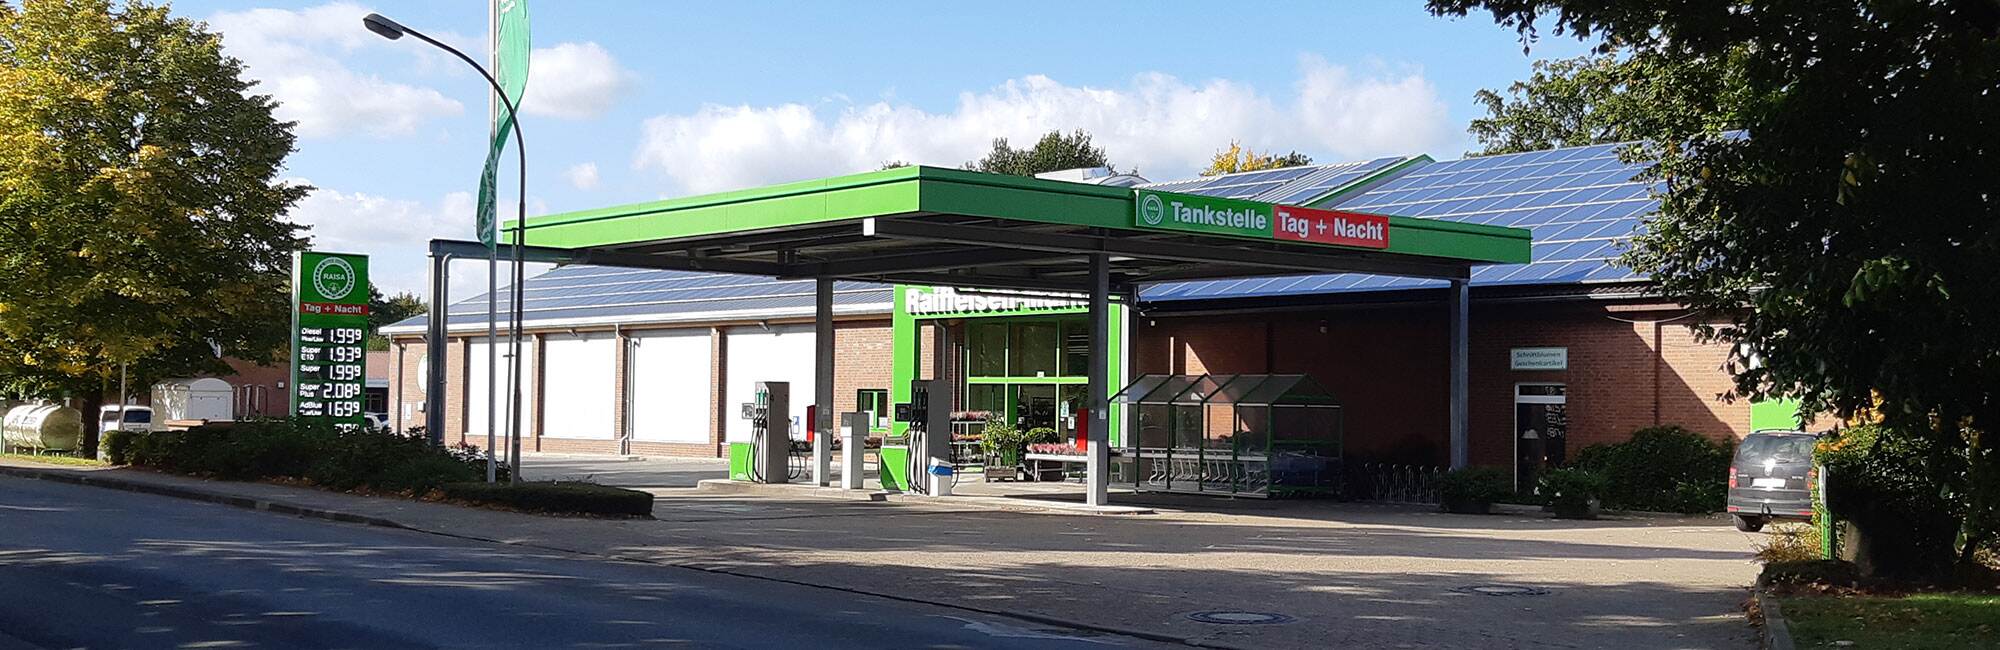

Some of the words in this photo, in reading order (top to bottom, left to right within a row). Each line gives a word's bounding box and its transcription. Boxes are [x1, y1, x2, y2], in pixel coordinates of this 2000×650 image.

[1171, 201, 1267, 229] Tankstelle
[1278, 212, 1309, 238] Tag
[1316, 219, 1328, 234] +
[1333, 217, 1383, 240] Nacht
[323, 273, 345, 281] RAISA
[304, 303, 321, 313] Tag
[334, 305, 362, 314] Nacht
[301, 327, 322, 335] Diesel
[330, 328, 362, 344] 1.999
[301, 346, 321, 354] Super
[330, 346, 362, 362] 1.939
[300, 364, 321, 373] Super
[329, 365, 361, 380] 1.999
[300, 383, 320, 391] Super
[323, 383, 360, 398] 2.089
[299, 401, 323, 409] AdBlue
